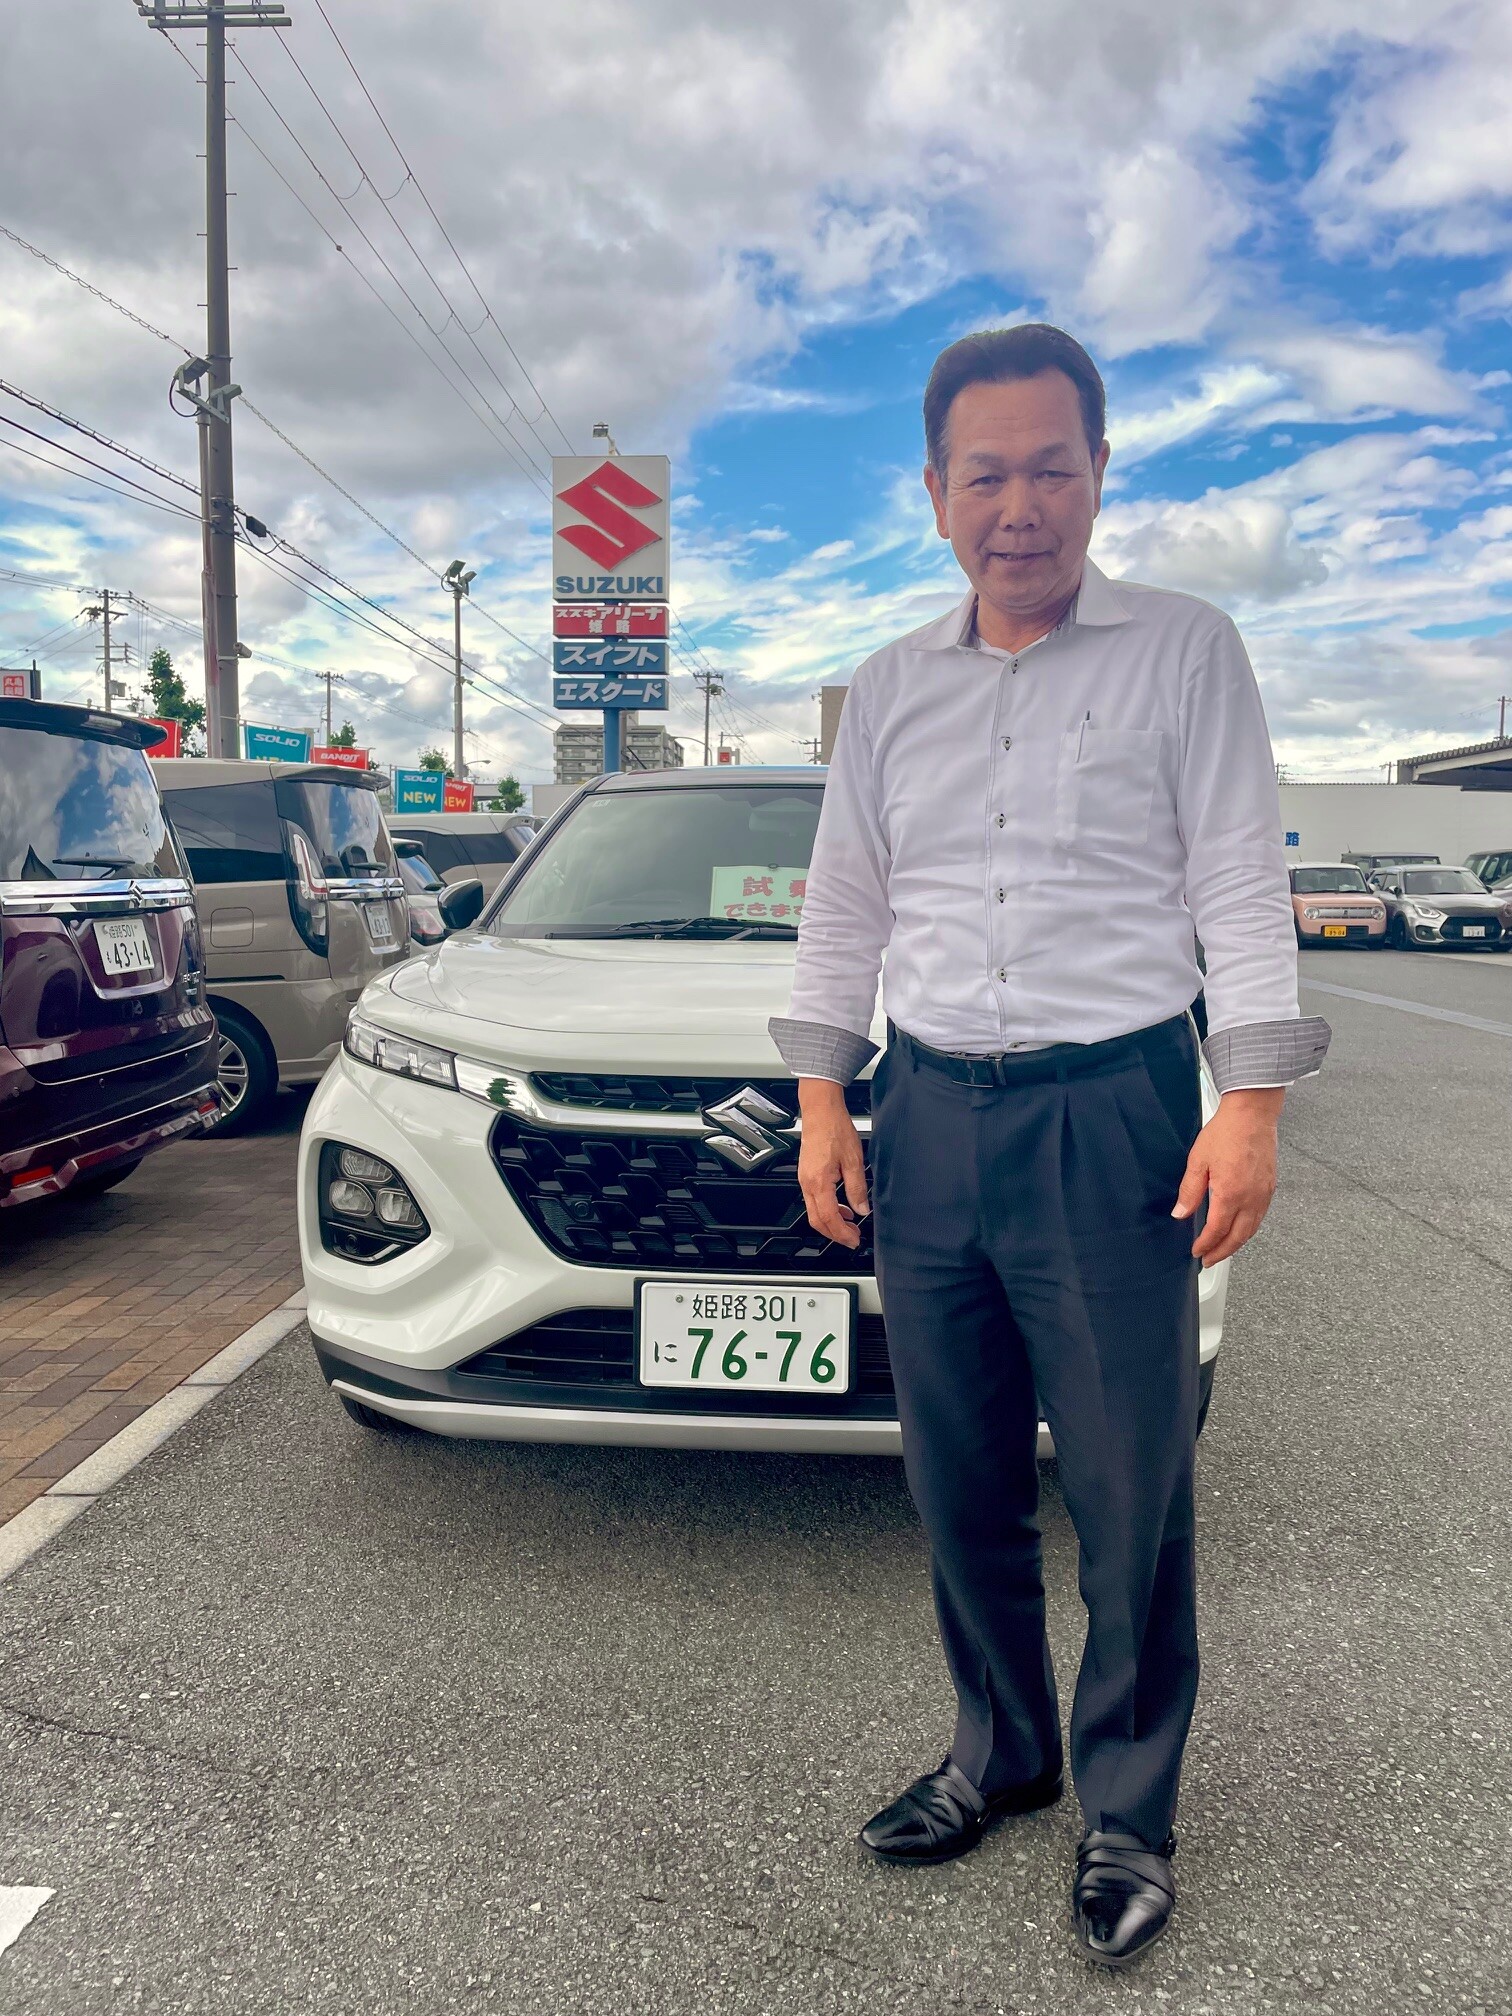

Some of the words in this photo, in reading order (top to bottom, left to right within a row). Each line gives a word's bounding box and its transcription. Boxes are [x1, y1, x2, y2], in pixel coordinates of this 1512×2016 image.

[556, 576, 663, 594] SUZUKI
[556, 607, 662, 621] スズキアリーナ
[560, 645, 660, 666] スイフト
[557, 682, 663, 703] エスクード
[254, 733, 300, 747] SOLIO
[320, 752, 360, 763] BANDIT
[403, 775, 438, 784] SOLIO
[404, 791, 436, 804] NEW
[653, 1341, 678, 1363] に
[687, 1327, 837, 1383] 76-76
